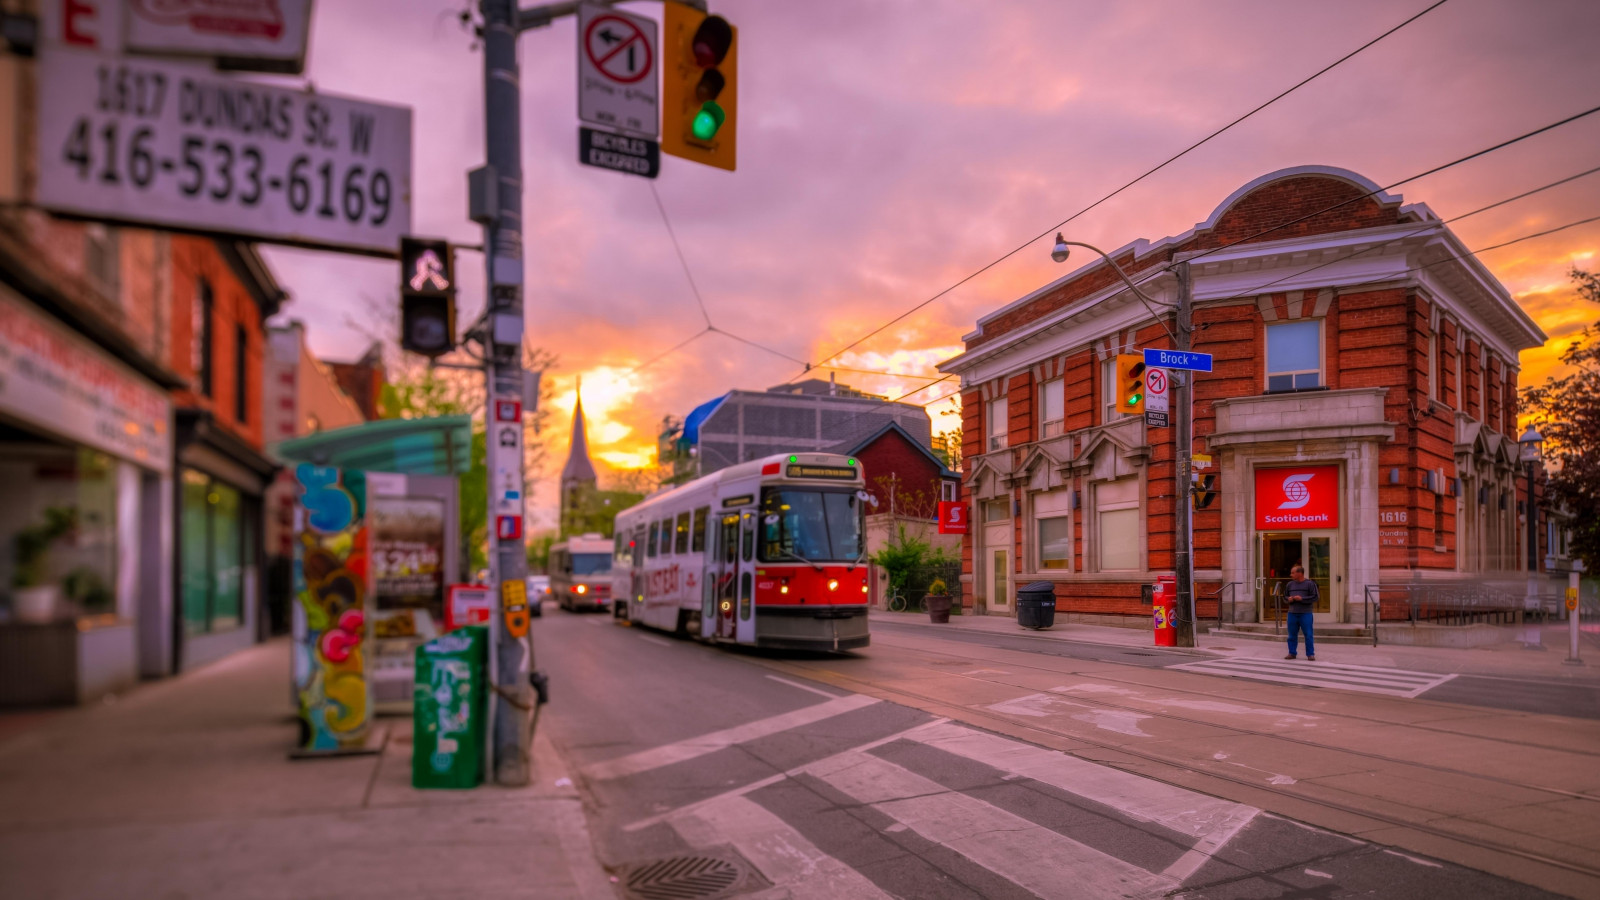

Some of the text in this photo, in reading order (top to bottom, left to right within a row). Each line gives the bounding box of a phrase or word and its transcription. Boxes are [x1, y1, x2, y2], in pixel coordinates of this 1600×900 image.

[97, 66, 375, 155] 1617 DUNDAS St. W
[591, 130, 648, 157] BICYCLES
[63, 117, 393, 227] 416-533-6169
[1160, 351, 1189, 365] Brock
[1264, 513, 1329, 523] Scotiabank
[1380, 511, 1407, 523] 1616
